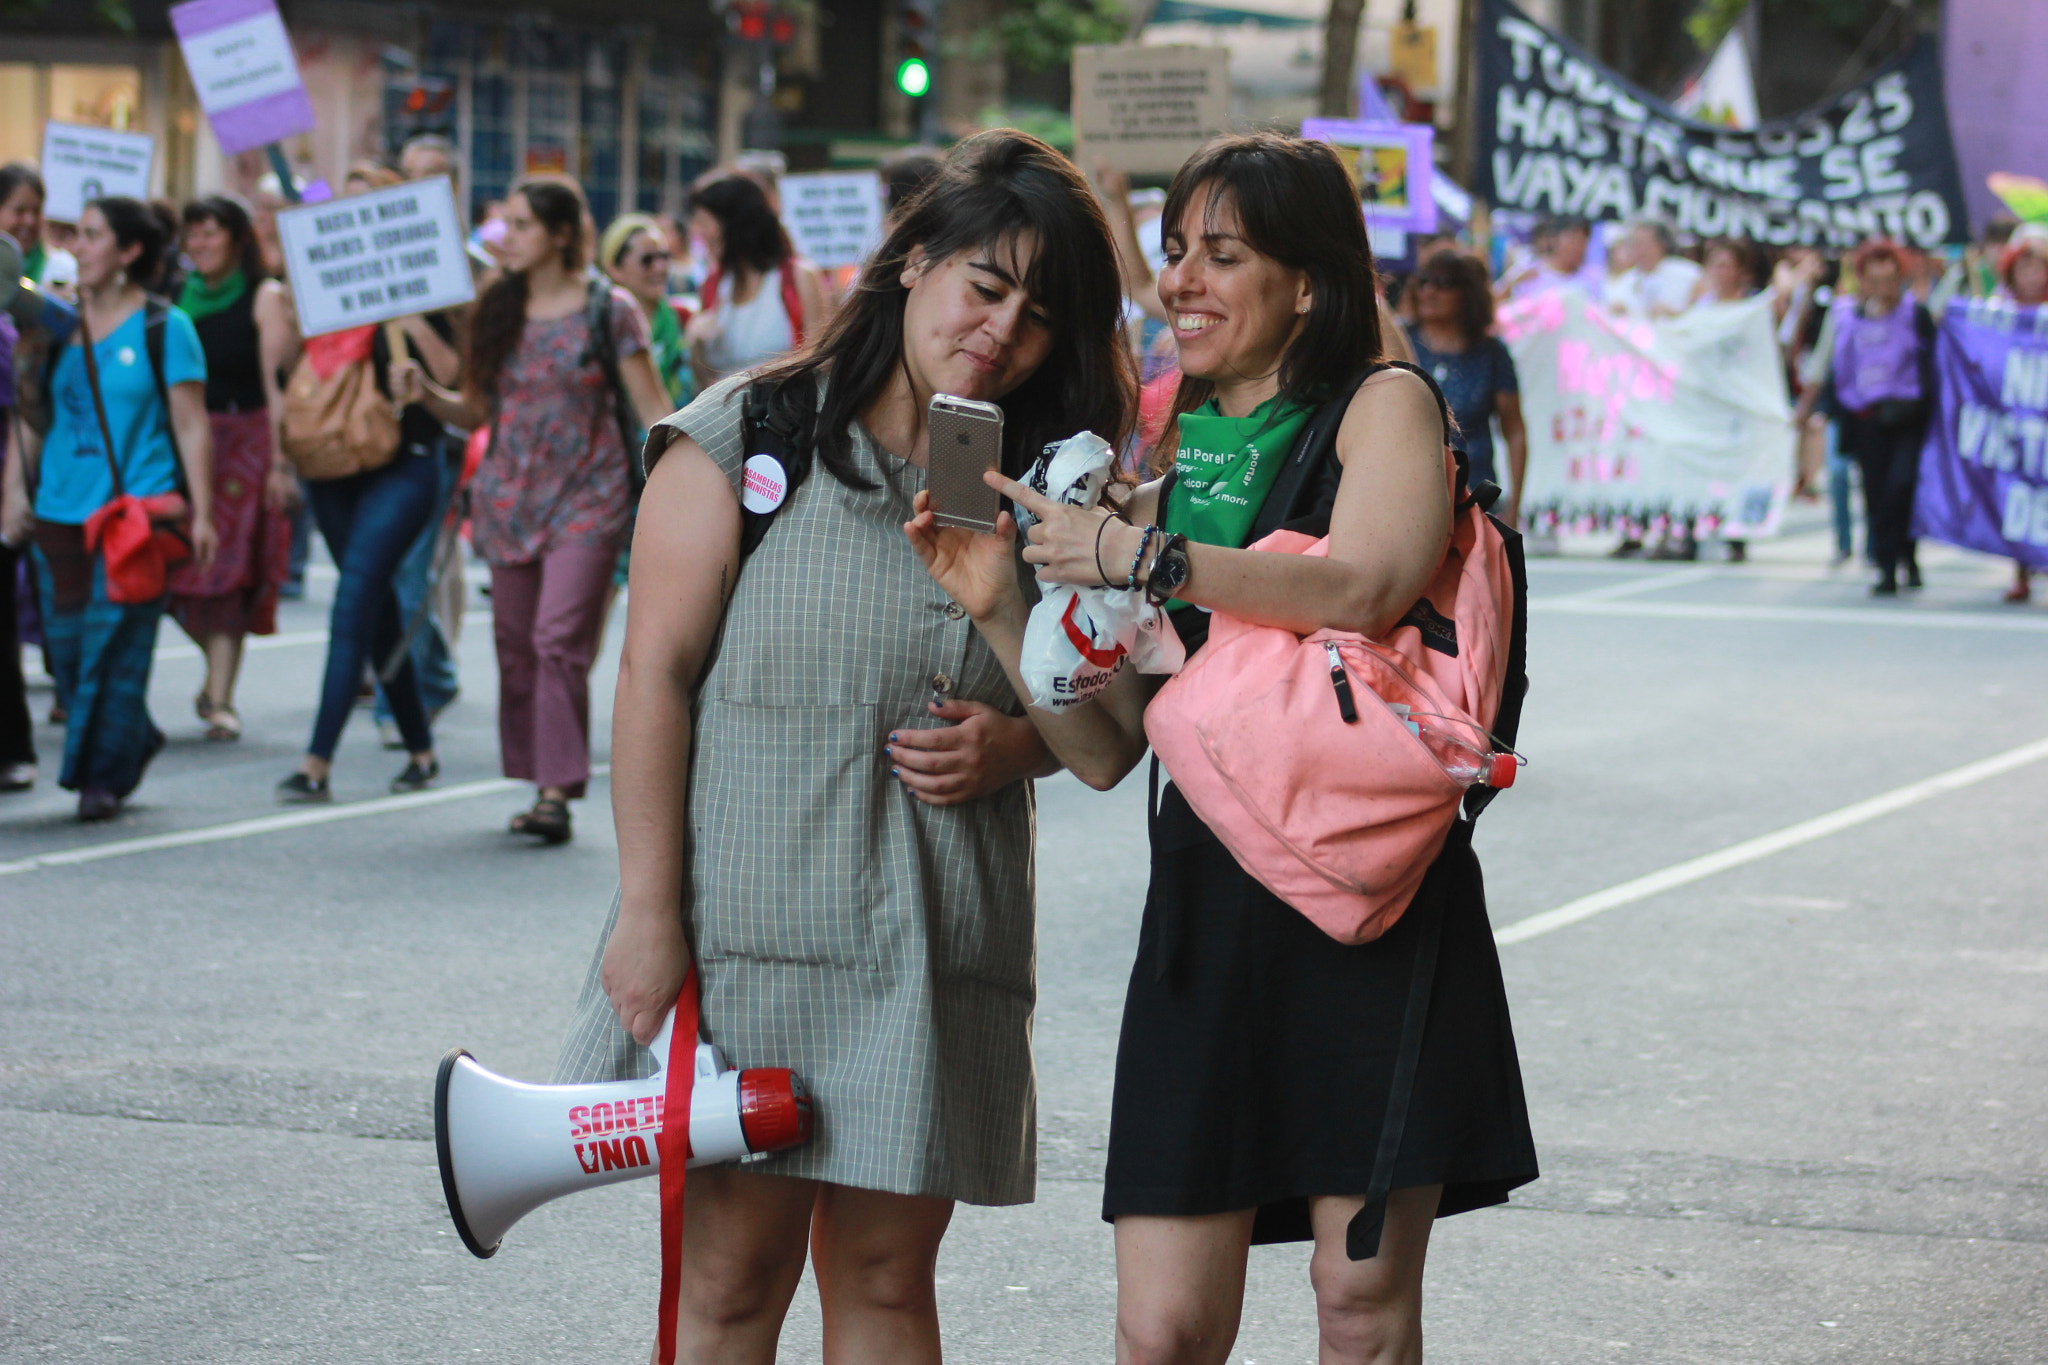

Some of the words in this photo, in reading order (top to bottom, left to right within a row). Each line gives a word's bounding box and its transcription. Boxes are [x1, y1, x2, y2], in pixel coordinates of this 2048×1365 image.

[1496, 84, 1686, 180] HASTA
[1686, 145, 1800, 200] QUE
[1820, 134, 1911, 200] SE
[1838, 72, 1914, 145] 25
[1492, 147, 1637, 220] VAYA
[743, 466, 782, 493] ASAMBLEAS
[574, 1135, 651, 1174] UNA
